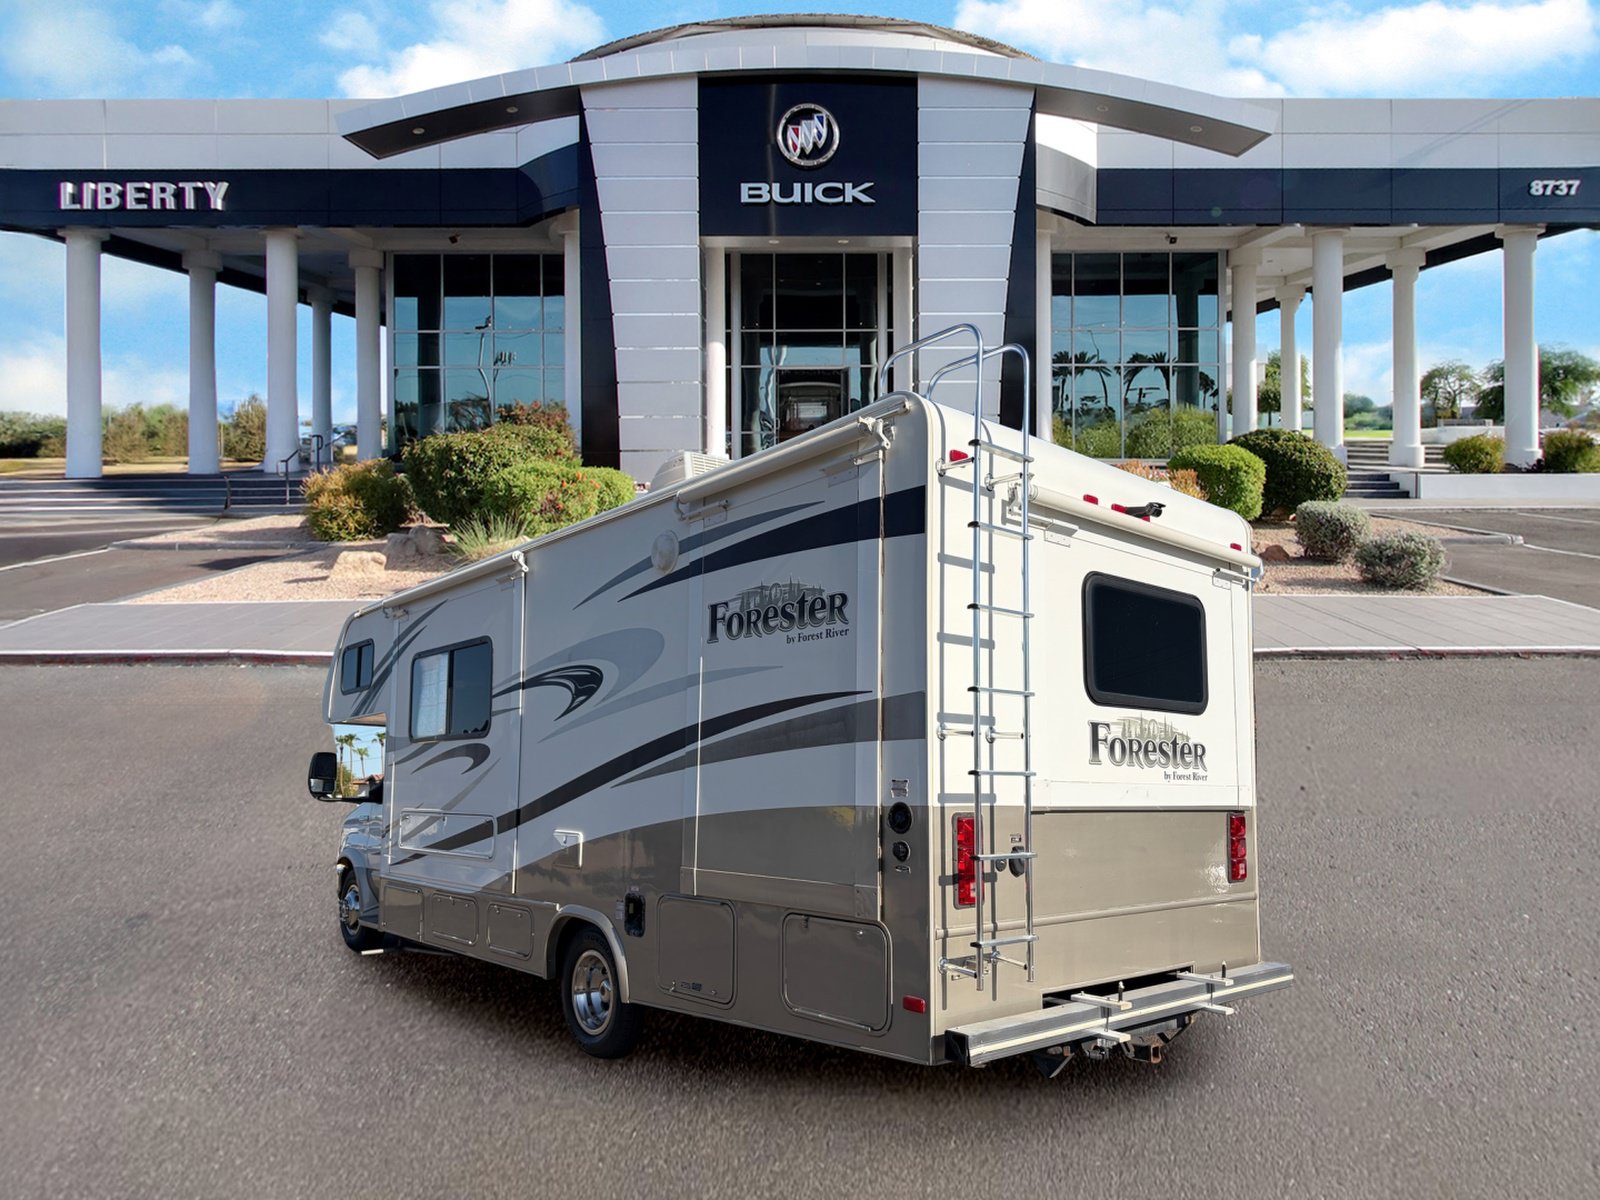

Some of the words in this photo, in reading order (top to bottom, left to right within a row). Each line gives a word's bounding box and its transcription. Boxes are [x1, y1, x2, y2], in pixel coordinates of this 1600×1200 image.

[59, 181, 229, 210] LIBERTY
[740, 182, 876, 204] BUICK
[1529, 179, 1581, 196] 8737
[786, 634, 796, 644] by
[797, 630, 823, 643] Forest
[825, 627, 850, 639] River
[1163, 771, 1172, 782] by
[1172, 771, 1192, 781] Forest
[1192, 772, 1208, 781] River
